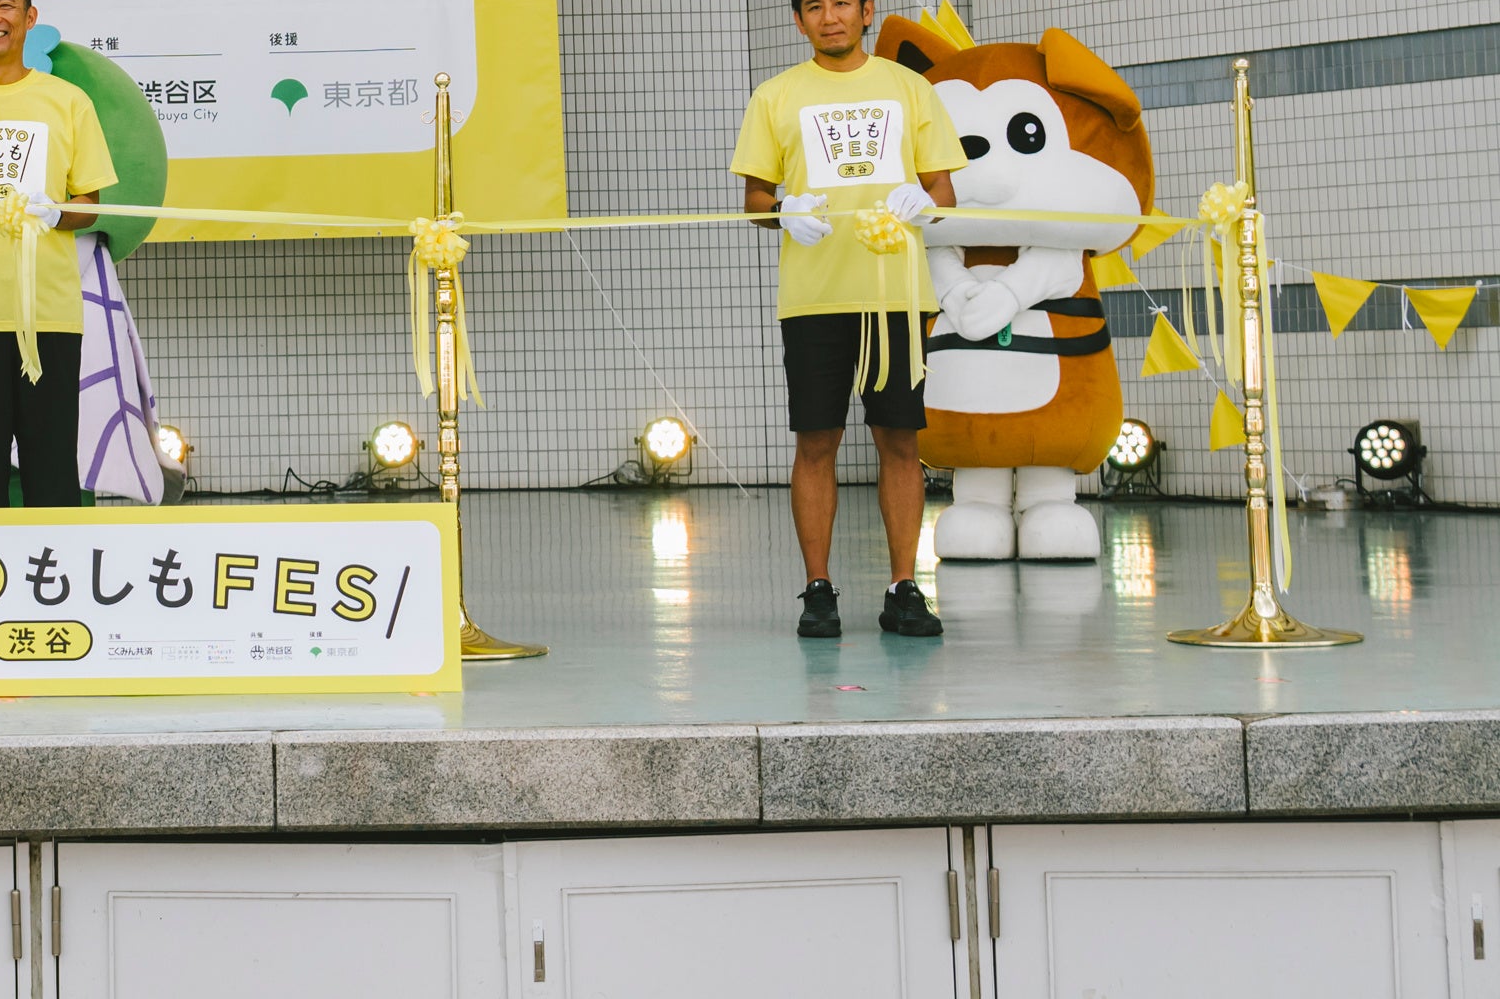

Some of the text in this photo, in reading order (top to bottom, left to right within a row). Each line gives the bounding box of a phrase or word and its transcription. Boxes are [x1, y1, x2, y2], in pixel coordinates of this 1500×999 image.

[90, 37, 119, 51] 共催
[269, 32, 298, 46] 後援
[322, 78, 419, 108] 東京都
[154, 107, 218, 123] buya City
[819, 108, 884, 123] TOKYO
[827, 122, 879, 141] もしも
[830, 140, 878, 159] FES
[25, 546, 194, 608] もしも
[212, 553, 378, 622] FES
[8, 627, 71, 654] 渋谷
[108, 647, 153, 656] こくみん共済
